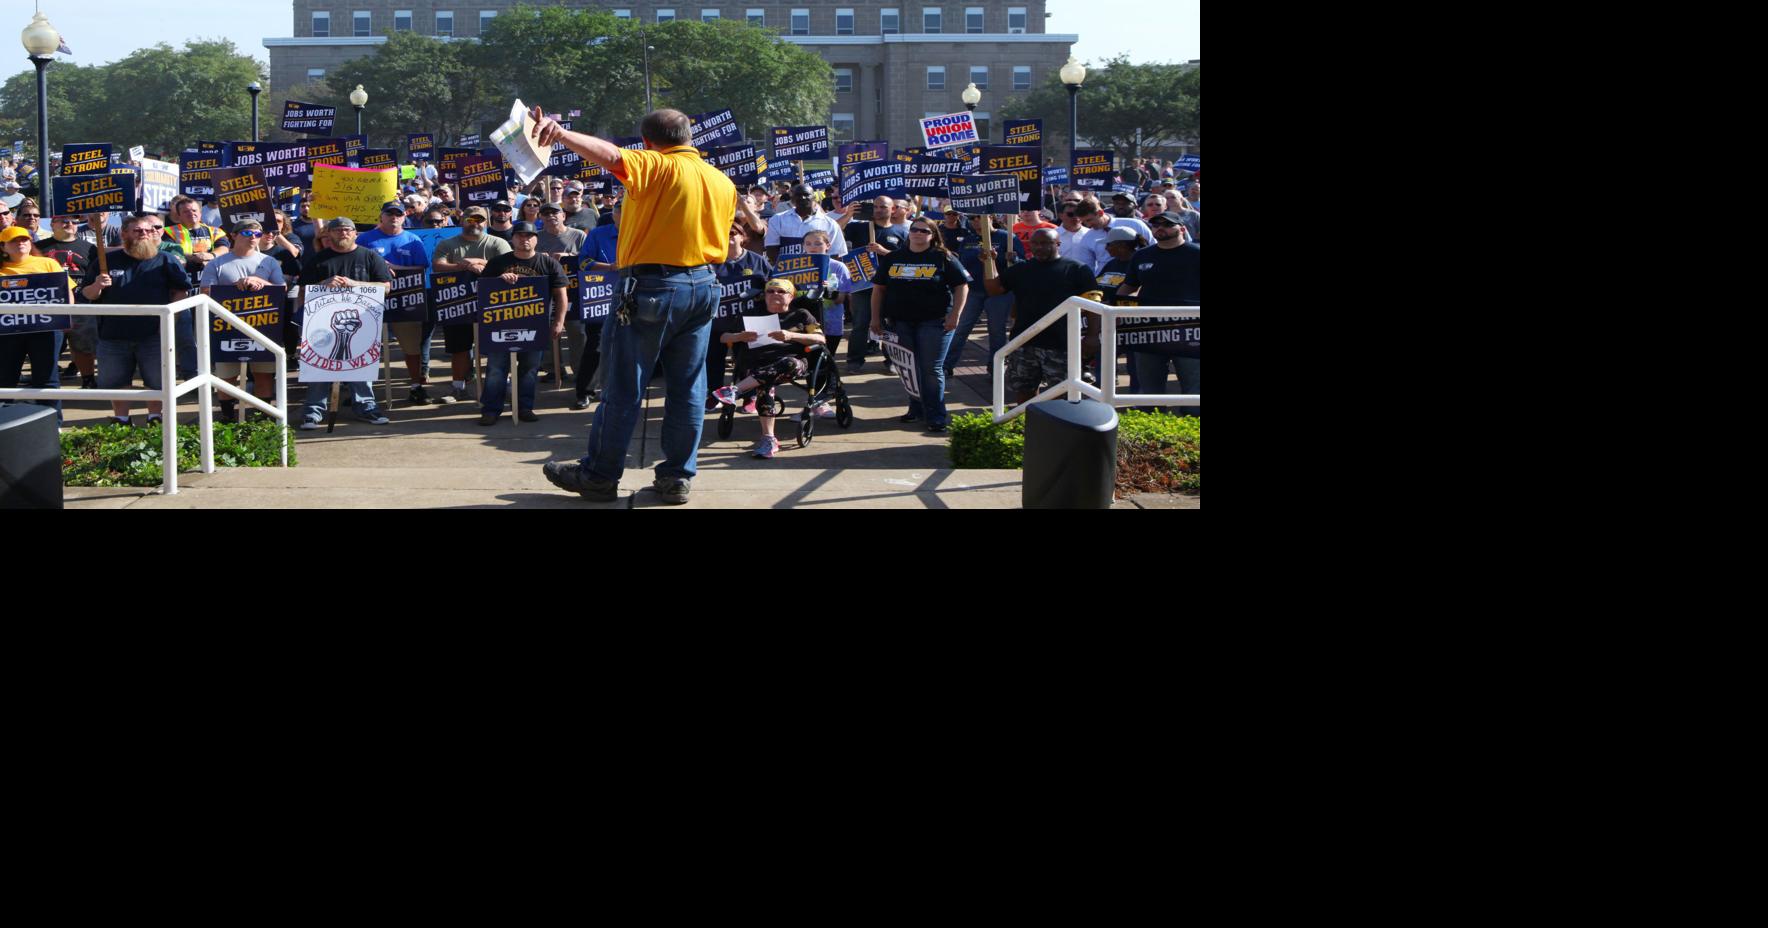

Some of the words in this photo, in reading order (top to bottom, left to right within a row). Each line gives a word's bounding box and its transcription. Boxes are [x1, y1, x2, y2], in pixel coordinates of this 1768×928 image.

[285, 110, 304, 118] JOBS
[306, 108, 334, 116] WORTH
[283, 120, 316, 128] FIGHTING
[690, 124, 702, 134] OBS
[703, 110, 732, 126] WORTH
[924, 114, 970, 128] PROUD
[692, 129, 720, 147] FIGHTING
[722, 122, 737, 134] FOR
[926, 122, 972, 136] UNION
[1010, 124, 1037, 134] STEEL
[346, 139, 362, 148] TEEL
[411, 136, 430, 144] STEEL
[774, 136, 793, 146] JOBS
[796, 128, 826, 142] WORTH
[1006, 133, 1040, 144] STRONG
[308, 144, 339, 156] STEEL
[410, 142, 432, 150] STRONG
[776, 144, 809, 158] FIGHTING
[812, 140, 827, 150] FOR
[70, 150, 104, 162] STEEL
[234, 153, 262, 166] JOBS
[266, 146, 306, 162] WORTH
[310, 155, 344, 168] TRONG
[364, 154, 391, 164] STEEL
[562, 153, 579, 163] FOR
[719, 148, 754, 165] WORTH
[846, 150, 879, 162] STEEL
[989, 155, 1032, 169] STEEL
[1077, 155, 1106, 164] STEEL
[64, 160, 107, 175] STRONG
[187, 159, 218, 170] STEEL
[287, 163, 306, 175] FOR
[464, 161, 496, 175] STEEL
[739, 162, 756, 175] FOR
[768, 160, 789, 169] WORTH
[904, 164, 918, 173] BS
[921, 162, 960, 173] WORTH
[1073, 166, 1110, 175] STRONG
[182, 171, 211, 182] STRO
[220, 174, 258, 191] STEEL
[461, 172, 502, 188] STRONG
[843, 172, 860, 191] JOBS
[864, 164, 902, 178] WORTH
[905, 177, 935, 188] HTING
[72, 176, 117, 195] STEEL
[842, 180, 881, 204] FIGHTING
[884, 177, 903, 188] FOR
[951, 185, 972, 195] JOBS
[976, 178, 1015, 192] WORTH
[66, 192, 124, 214] STRONG
[144, 183, 178, 209] STEE
[220, 188, 267, 208] STRONG
[468, 192, 498, 200] USW
[952, 196, 994, 208] FIGHTING
[997, 192, 1017, 202] FOR
[778, 256, 814, 272] STEEL
[888, 266, 937, 277] USW
[390, 273, 422, 290] ORTH
[781, 271, 820, 286] RONG
[0, 287, 59, 302] OTECT
[436, 284, 466, 302] JOBS
[490, 286, 538, 304] STEEL
[583, 284, 612, 300] JOBS
[720, 280, 752, 297] ORTH
[222, 295, 272, 311] STEEL
[402, 292, 424, 307] FOR
[437, 300, 478, 321] FIGHTI
[483, 302, 544, 323] STRONG
[584, 303, 610, 319] FIGH
[0, 314, 52, 326] GHTS
[492, 330, 536, 342] USW
[1117, 328, 1180, 345] FIGHTING
[1185, 328, 1200, 341] FO
[300, 340, 342, 370] DIVIDED
[348, 354, 368, 368] WE
